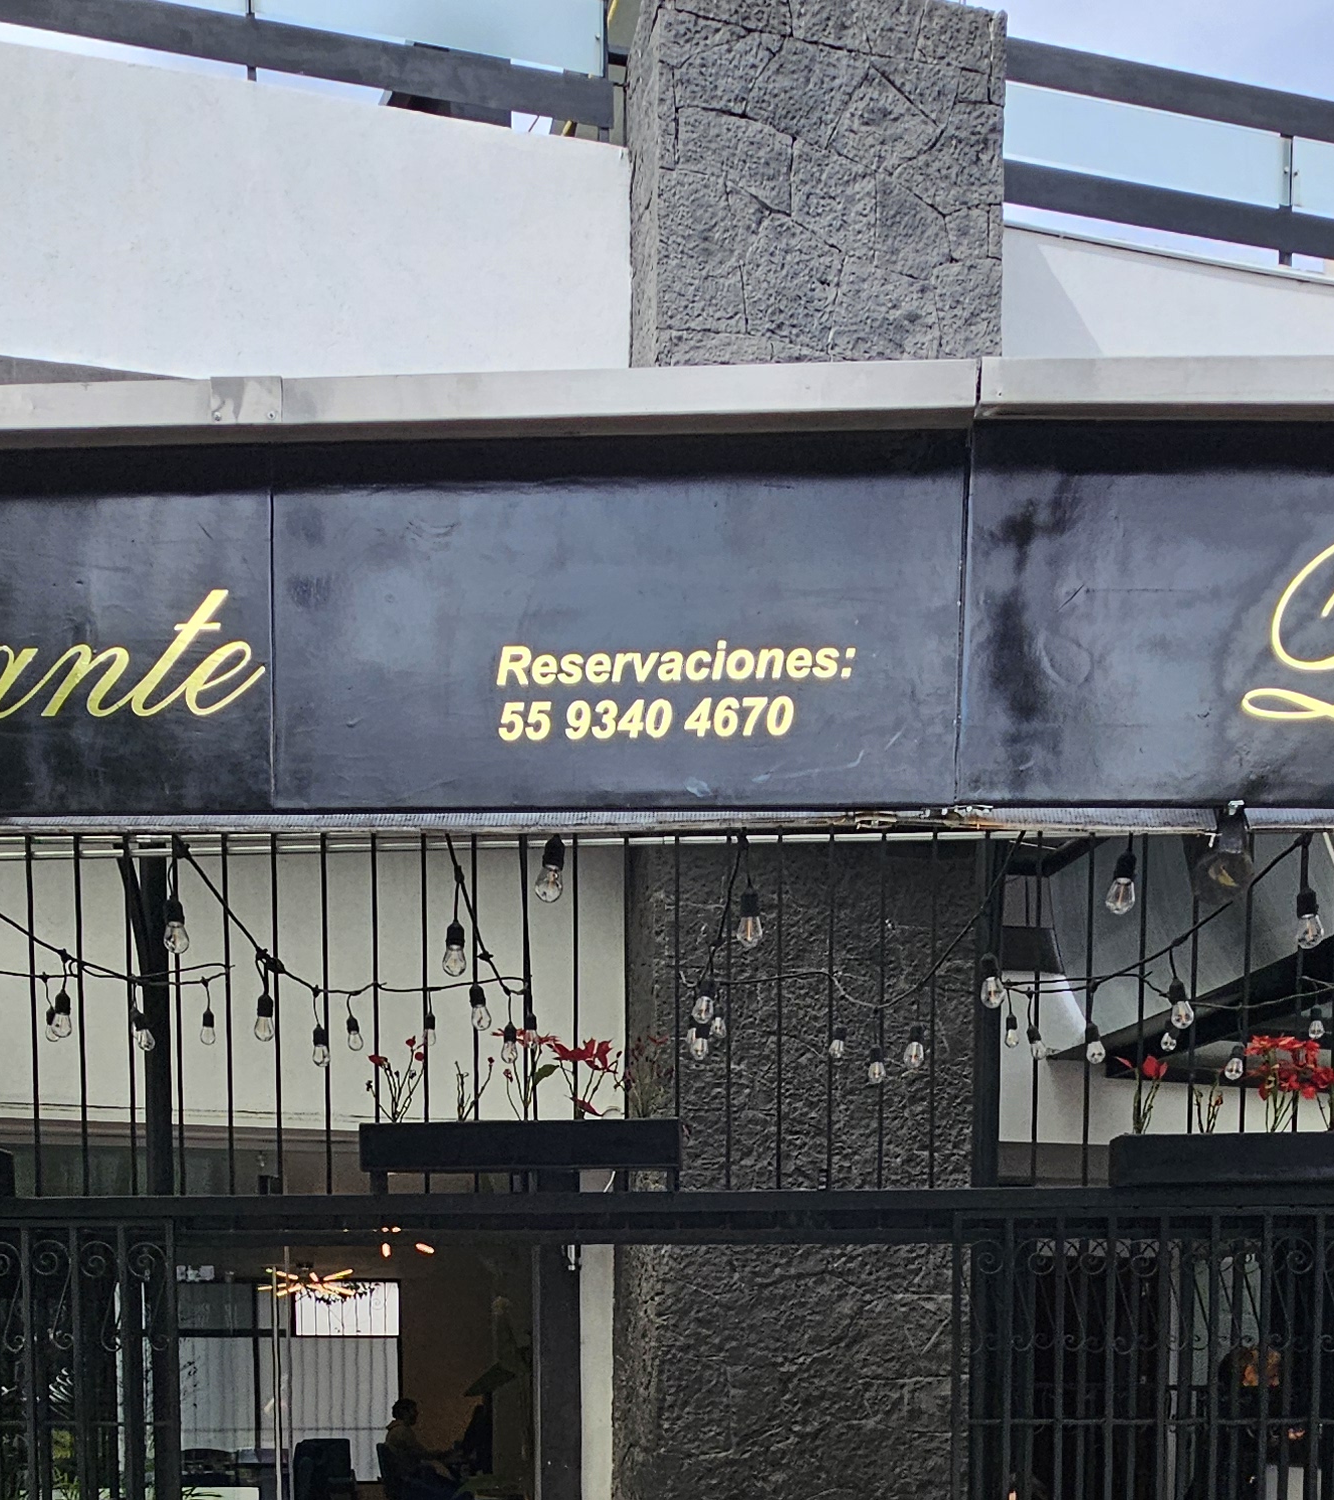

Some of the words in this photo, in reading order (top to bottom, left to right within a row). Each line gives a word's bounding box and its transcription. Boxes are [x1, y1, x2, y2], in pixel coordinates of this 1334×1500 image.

[496, 639, 857, 687] Reservaciones:
[498, 701, 552, 741] 55
[565, 698, 673, 740] 9340
[683, 696, 795, 737] 4670
